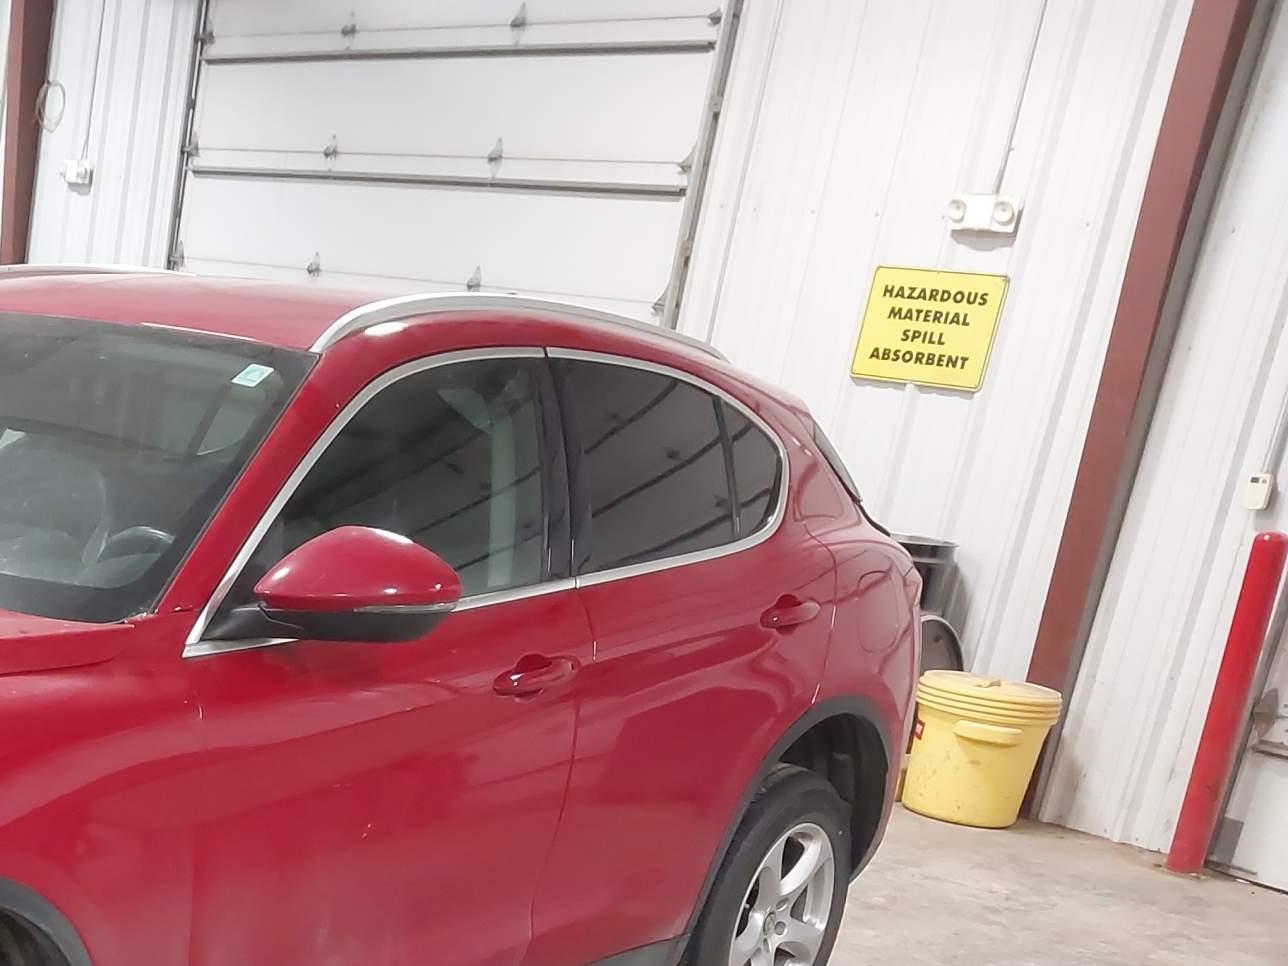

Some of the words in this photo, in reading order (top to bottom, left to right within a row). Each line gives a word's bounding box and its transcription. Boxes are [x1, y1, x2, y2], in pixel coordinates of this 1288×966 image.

[882, 284, 990, 306] HAZARDOUS
[887, 306, 970, 326] MATERIAL
[900, 329, 946, 346] SPILL
[869, 347, 969, 370] ABSORBENT
